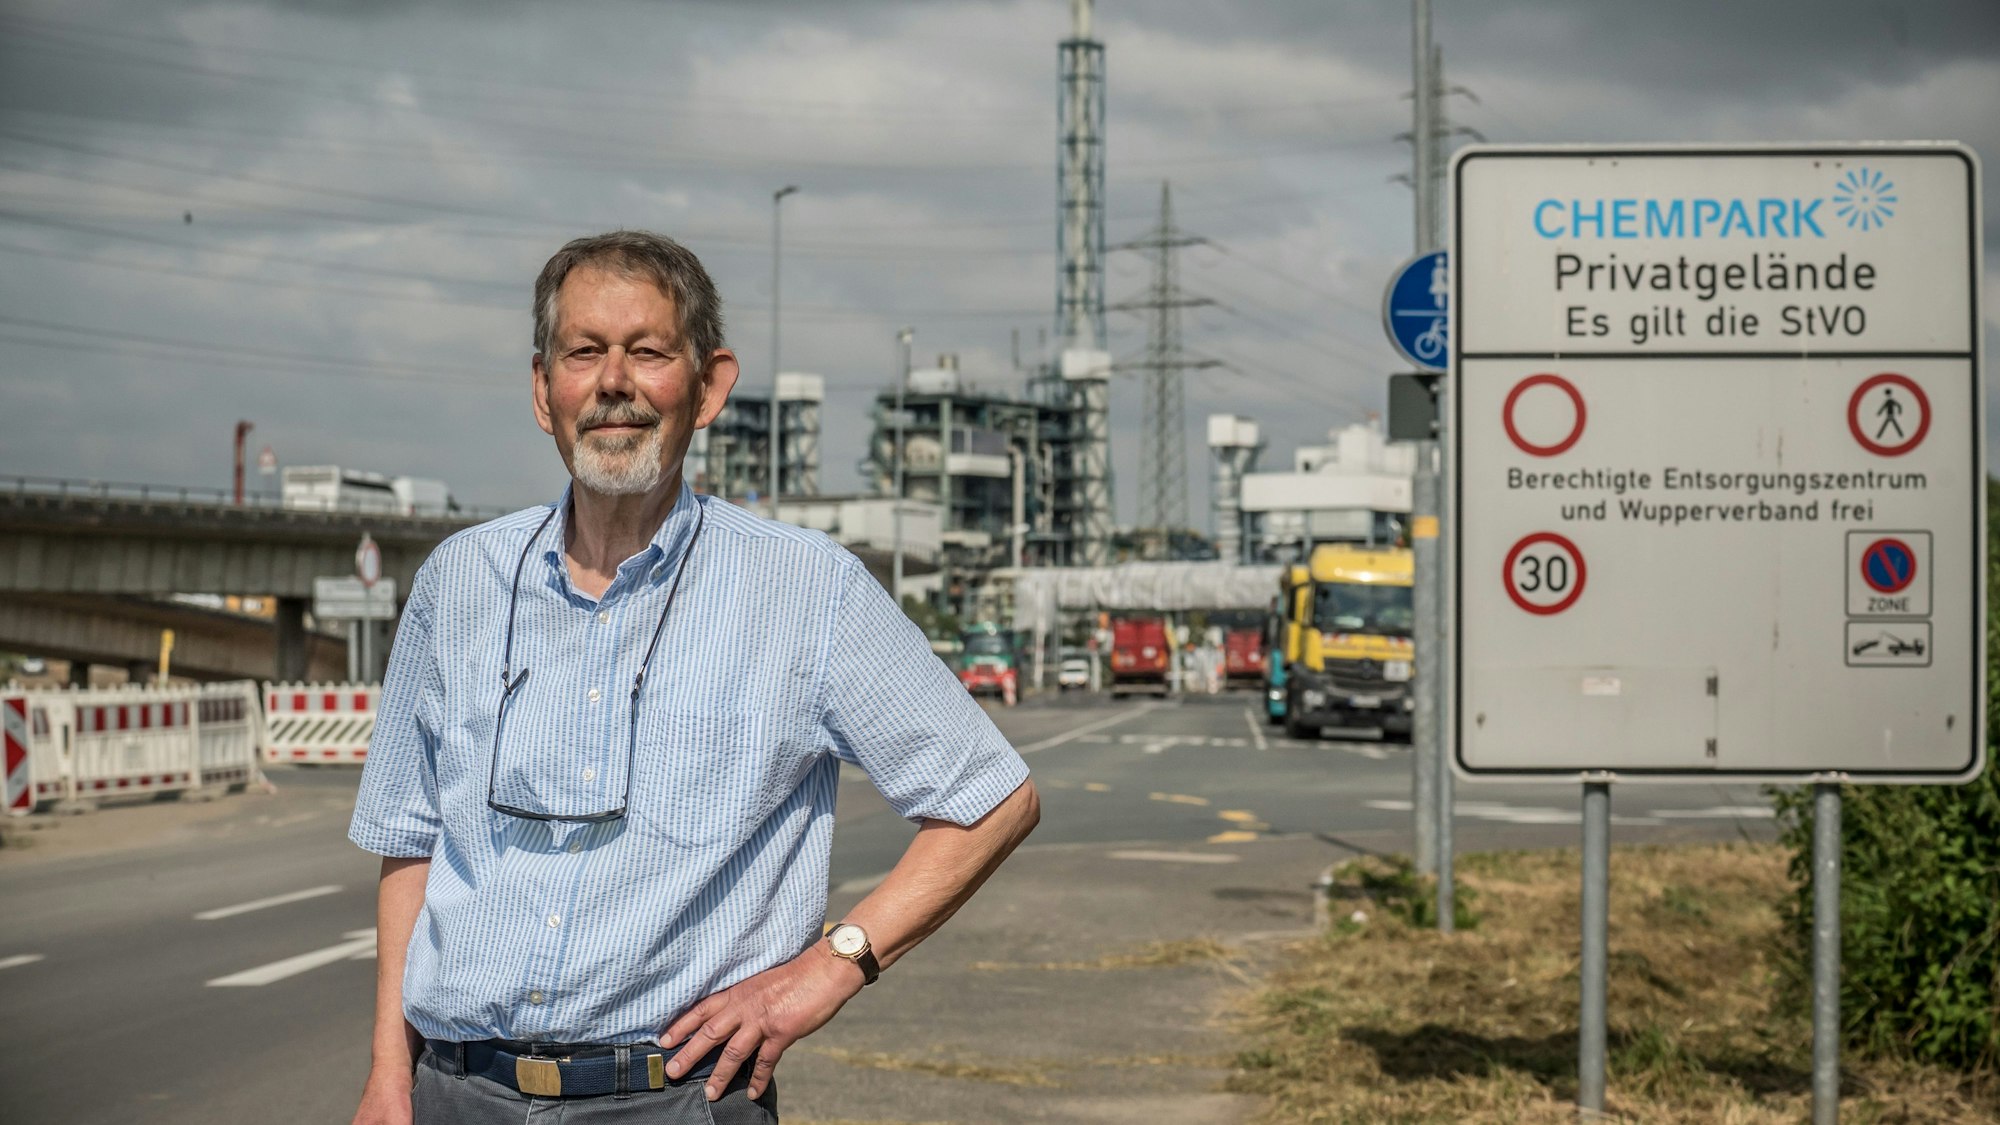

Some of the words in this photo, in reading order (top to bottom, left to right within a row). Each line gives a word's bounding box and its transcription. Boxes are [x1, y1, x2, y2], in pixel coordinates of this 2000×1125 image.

[1533, 199, 1826, 239] CHEMPARK
[1555, 253, 1877, 301] Privatgelände
[1566, 306, 1610, 337] Es
[1630, 306, 1687, 344] gilt
[1706, 306, 1760, 337] die
[1781, 306, 1867, 337] StVO
[1507, 467, 1652, 495] Berechtigte
[1664, 467, 1928, 495] Entsorgungszentrum
[1561, 500, 1607, 522] und
[1620, 500, 1819, 526] Wupperverband
[1831, 500, 1875, 522] frei
[1519, 555, 1568, 593] 30
[1867, 598, 1911, 613] ZONE
